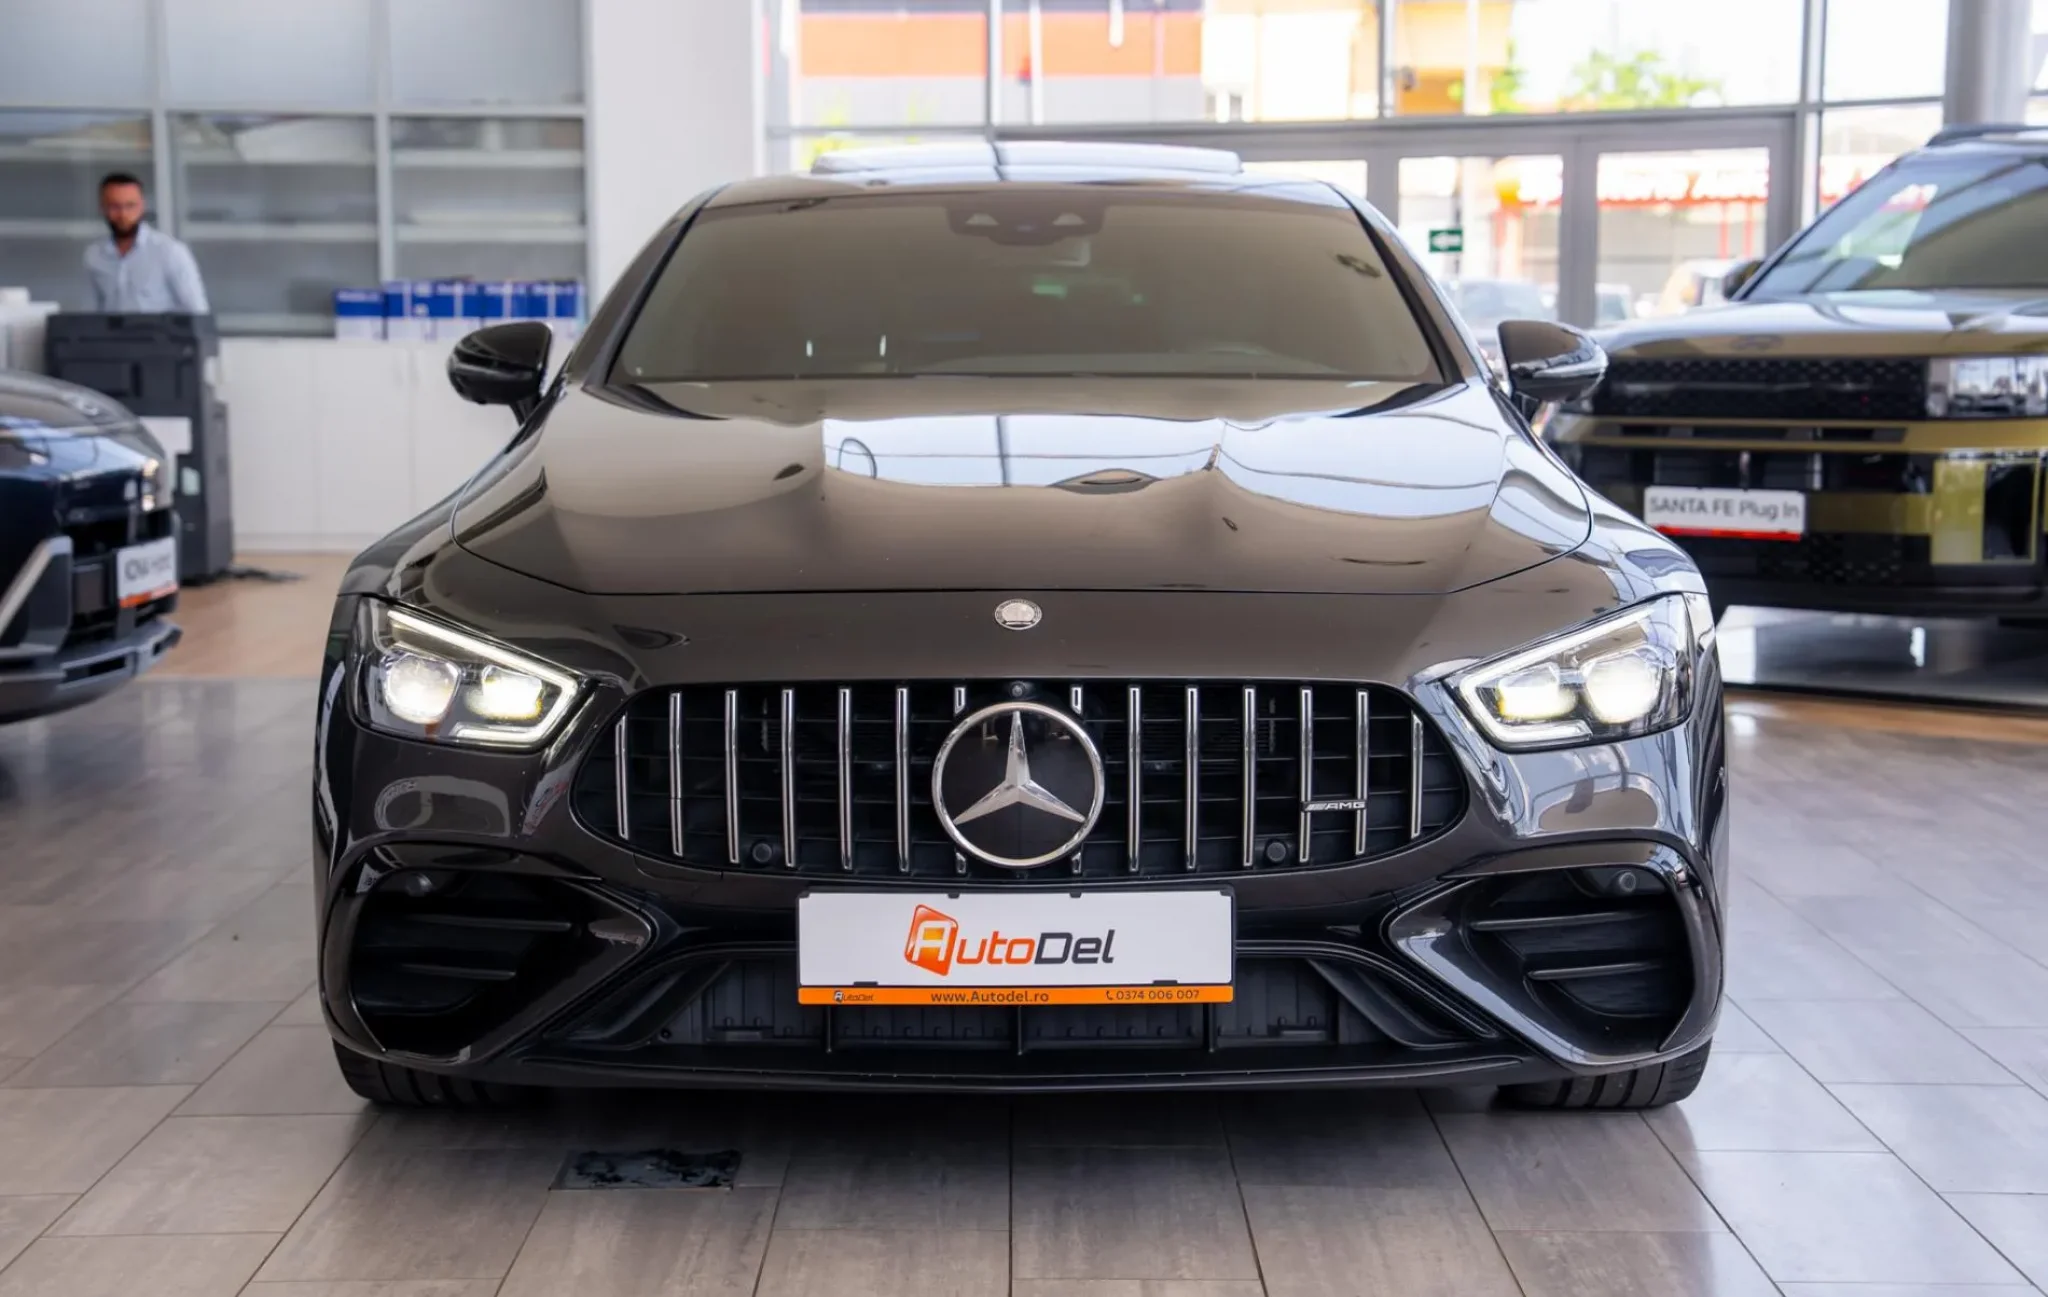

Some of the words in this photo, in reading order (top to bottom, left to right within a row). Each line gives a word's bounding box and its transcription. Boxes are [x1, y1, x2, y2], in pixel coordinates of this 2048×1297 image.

[1649, 496, 1708, 514] SANTA
[1712, 497, 1735, 517] FE
[1739, 499, 1779, 523] Plug
[1325, 801, 1366, 811] AMG
[912, 916, 1115, 965] AutoDel
[930, 990, 1050, 1003] www.Autodel.ro
[1116, 990, 1145, 1001] 0374
[1148, 990, 1173, 1000] 006
[1176, 989, 1200, 1000] 007
